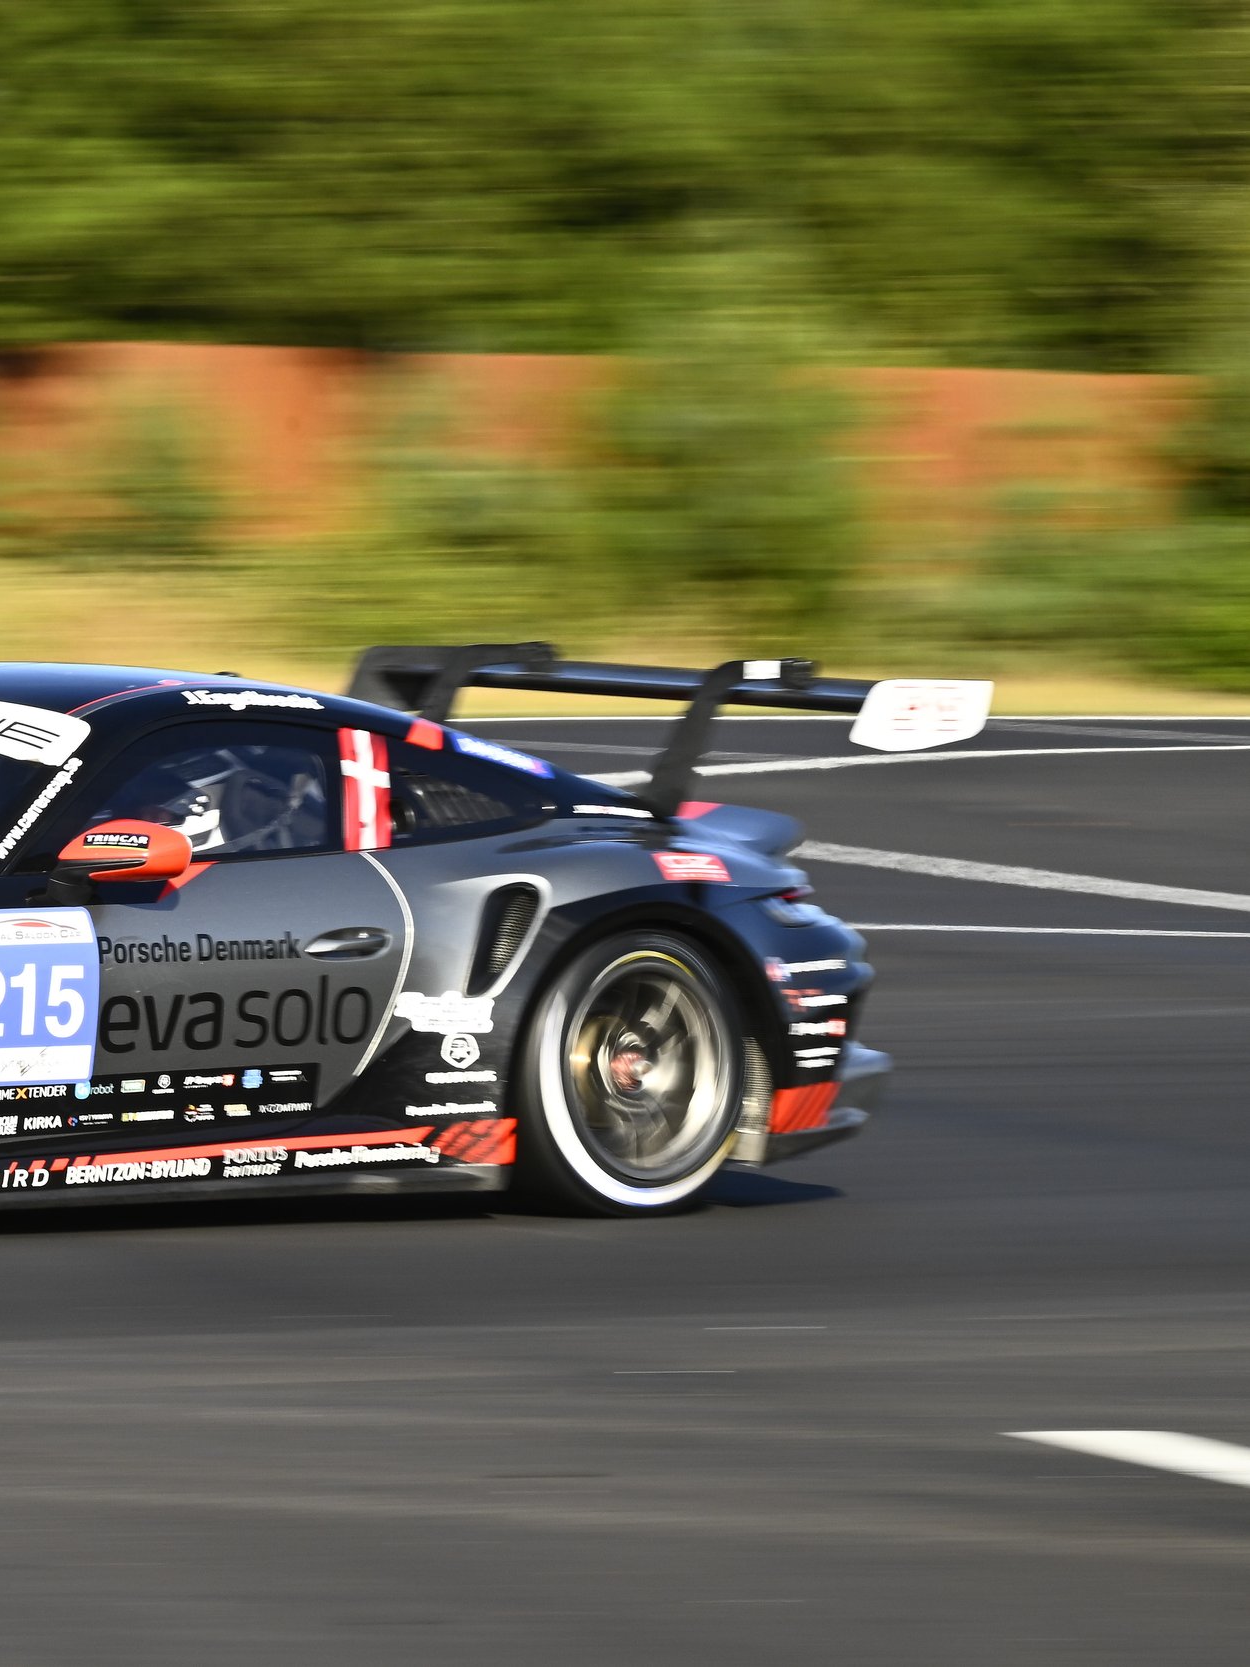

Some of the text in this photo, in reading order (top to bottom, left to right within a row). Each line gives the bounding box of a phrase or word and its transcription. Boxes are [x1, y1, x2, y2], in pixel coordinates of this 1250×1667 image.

[86, 834, 148, 844] TRIMCAR
[98, 931, 301, 964] Porsche Denmark
[23, 1115, 62, 1130] KIRKA
